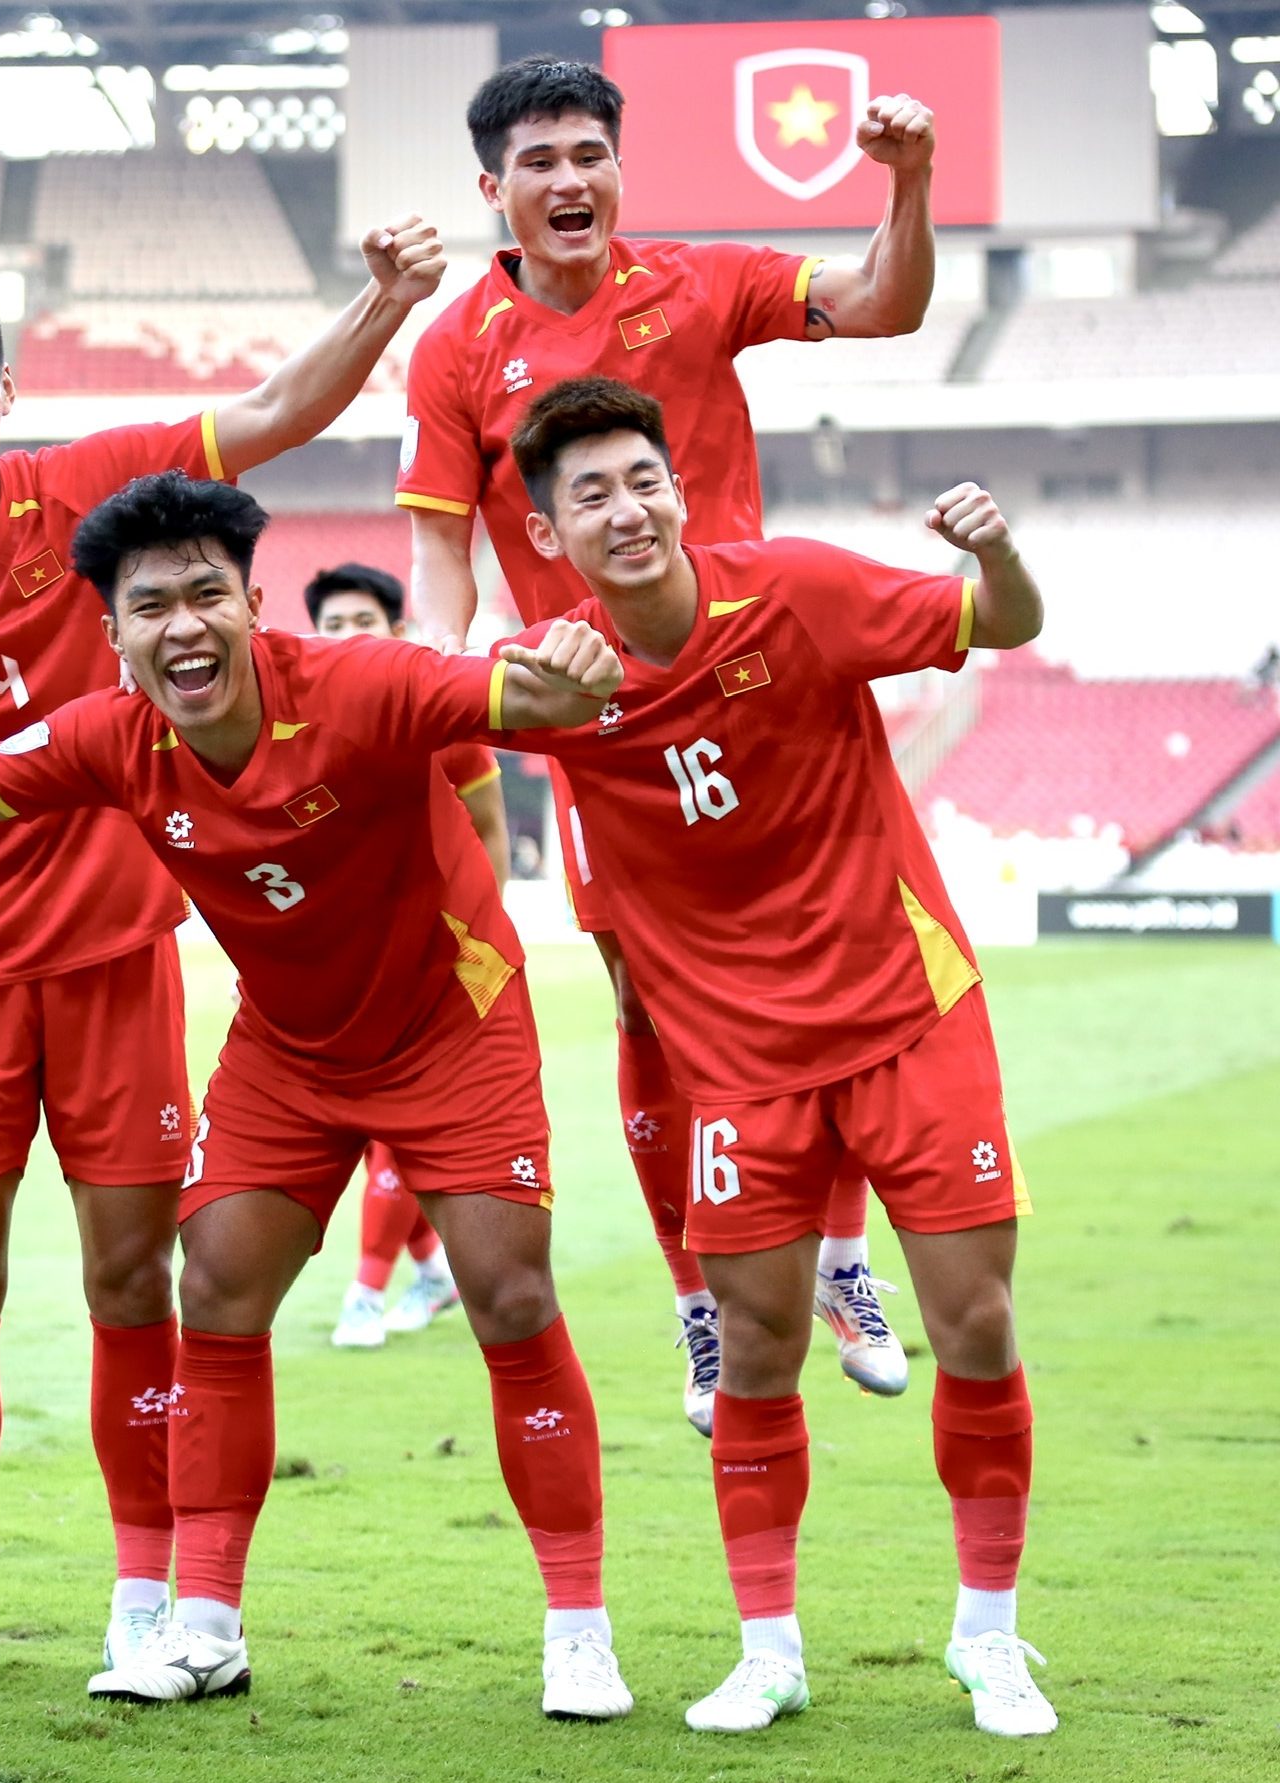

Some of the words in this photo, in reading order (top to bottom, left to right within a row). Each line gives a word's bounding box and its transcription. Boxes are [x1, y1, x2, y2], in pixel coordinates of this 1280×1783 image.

[663, 737, 740, 827] 16
[243, 862, 306, 912] 3
[692, 1116, 741, 1206] 16
